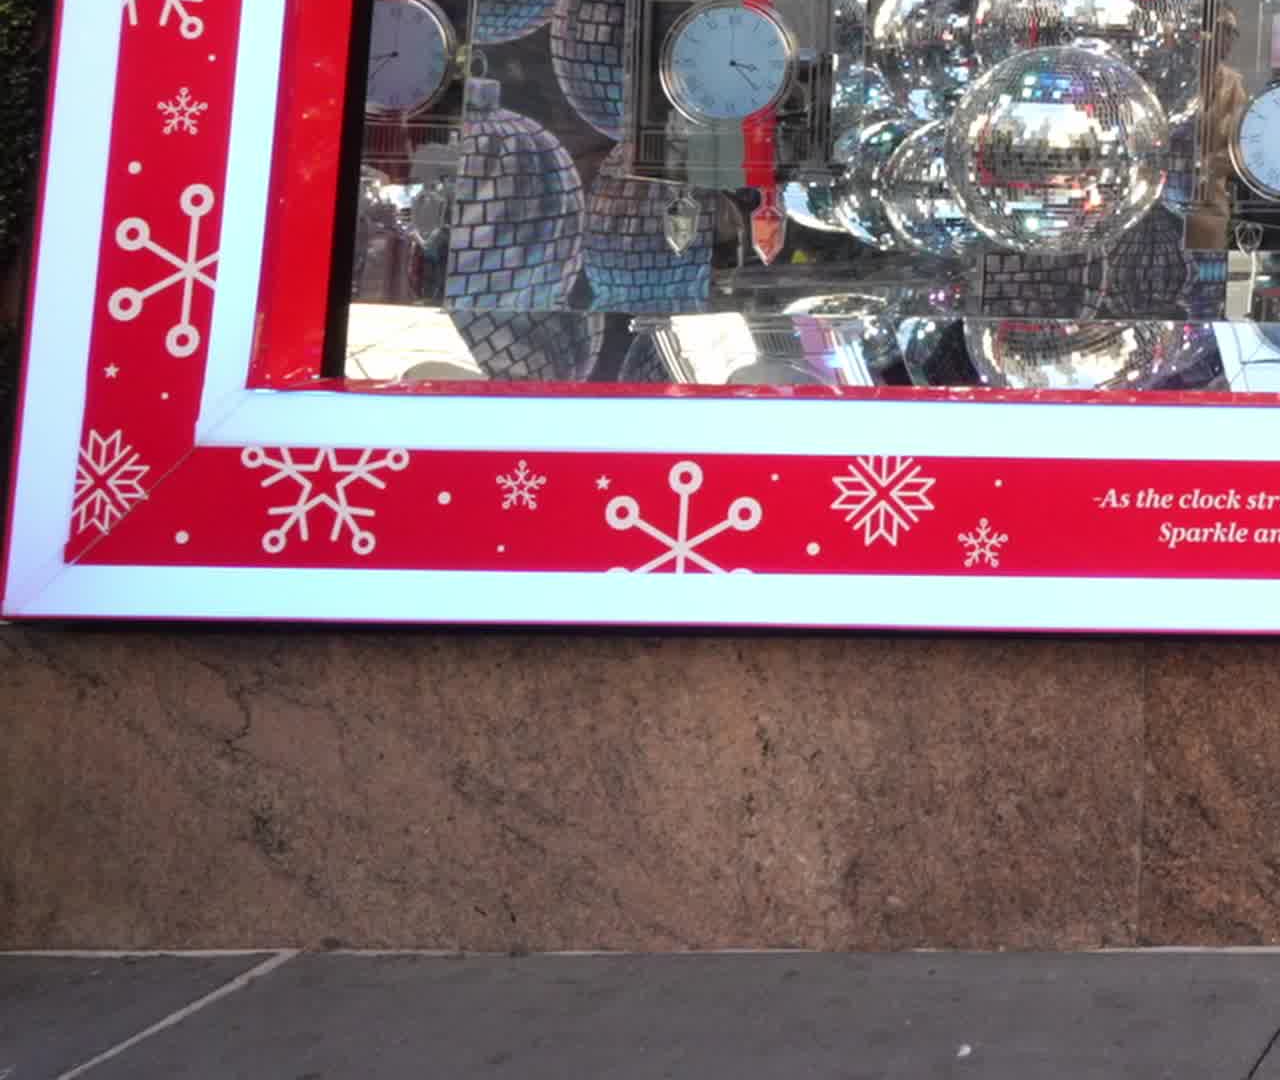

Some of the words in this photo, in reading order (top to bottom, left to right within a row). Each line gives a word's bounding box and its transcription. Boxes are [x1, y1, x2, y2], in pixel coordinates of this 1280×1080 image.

[1136, 488, 1174, 508] the
[1179, 489, 1241, 509] clock
[1159, 522, 1248, 548] Sparkle
